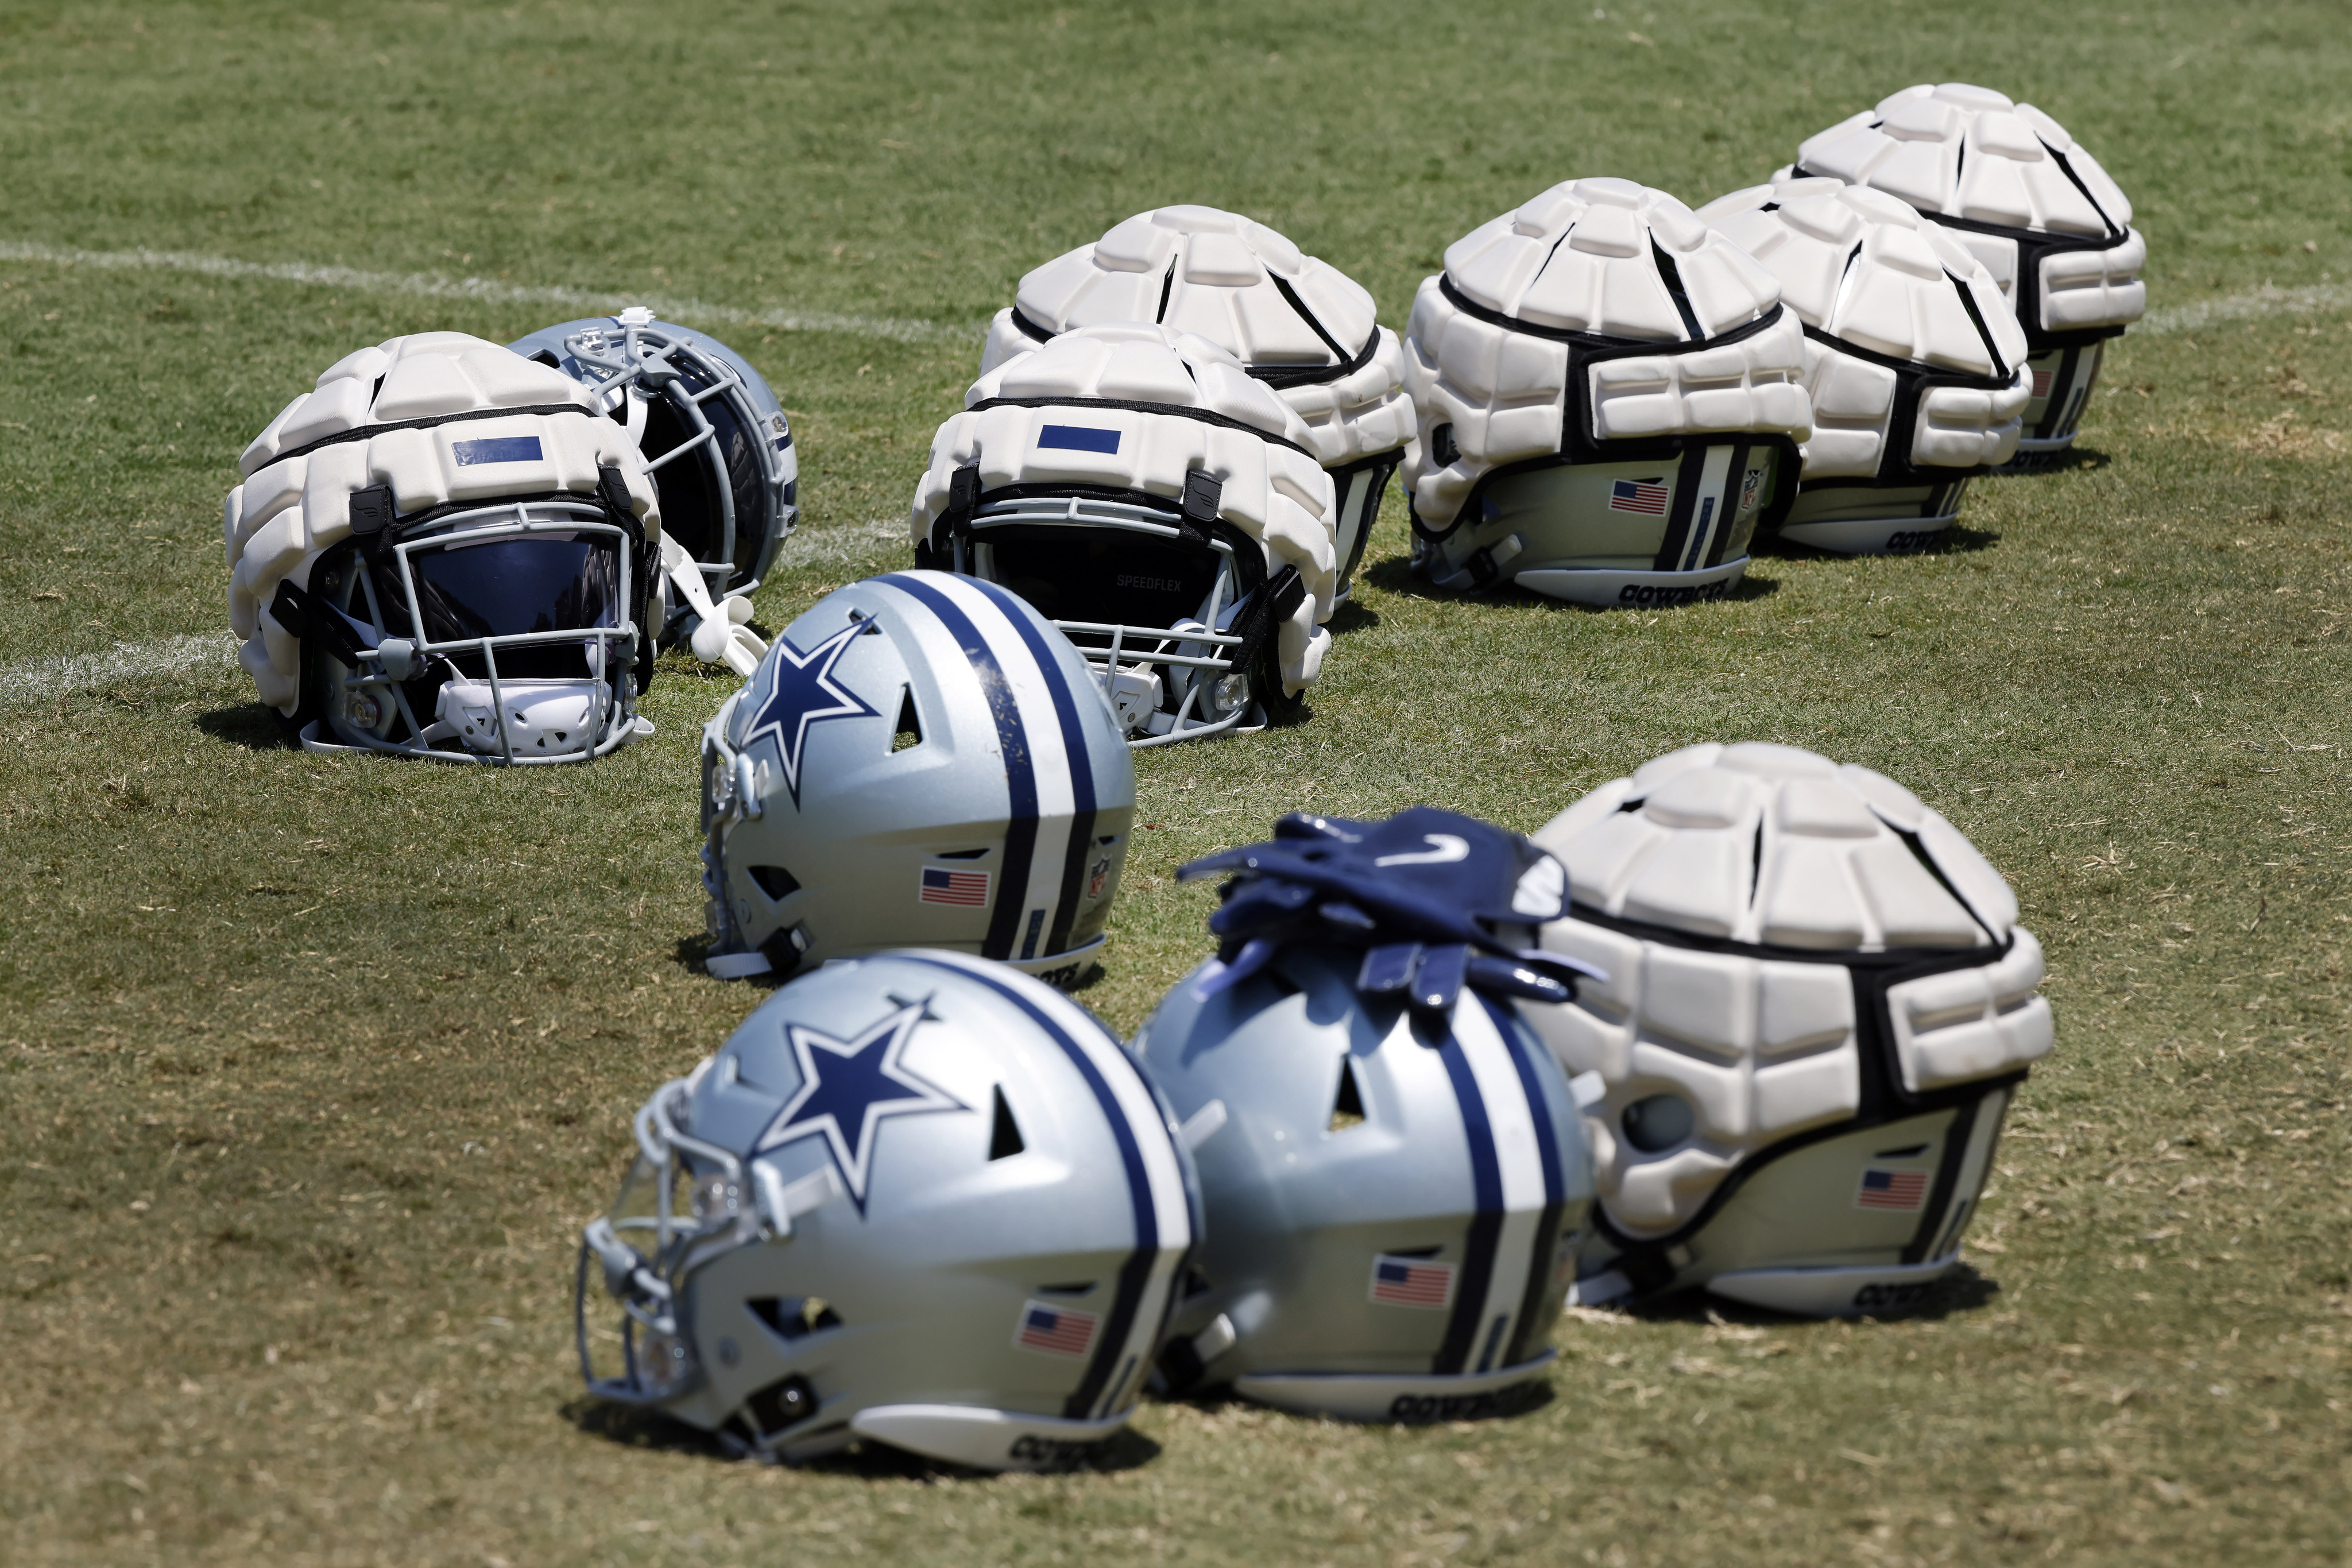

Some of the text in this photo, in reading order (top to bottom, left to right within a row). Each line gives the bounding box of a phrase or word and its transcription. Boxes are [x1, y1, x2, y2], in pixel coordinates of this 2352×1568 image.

[1886, 531, 1941, 549] COW
[1117, 575, 1181, 592] SPEEDFLEX
[1619, 577, 1730, 604] COWBOYS
[1032, 961, 1081, 986] OYS
